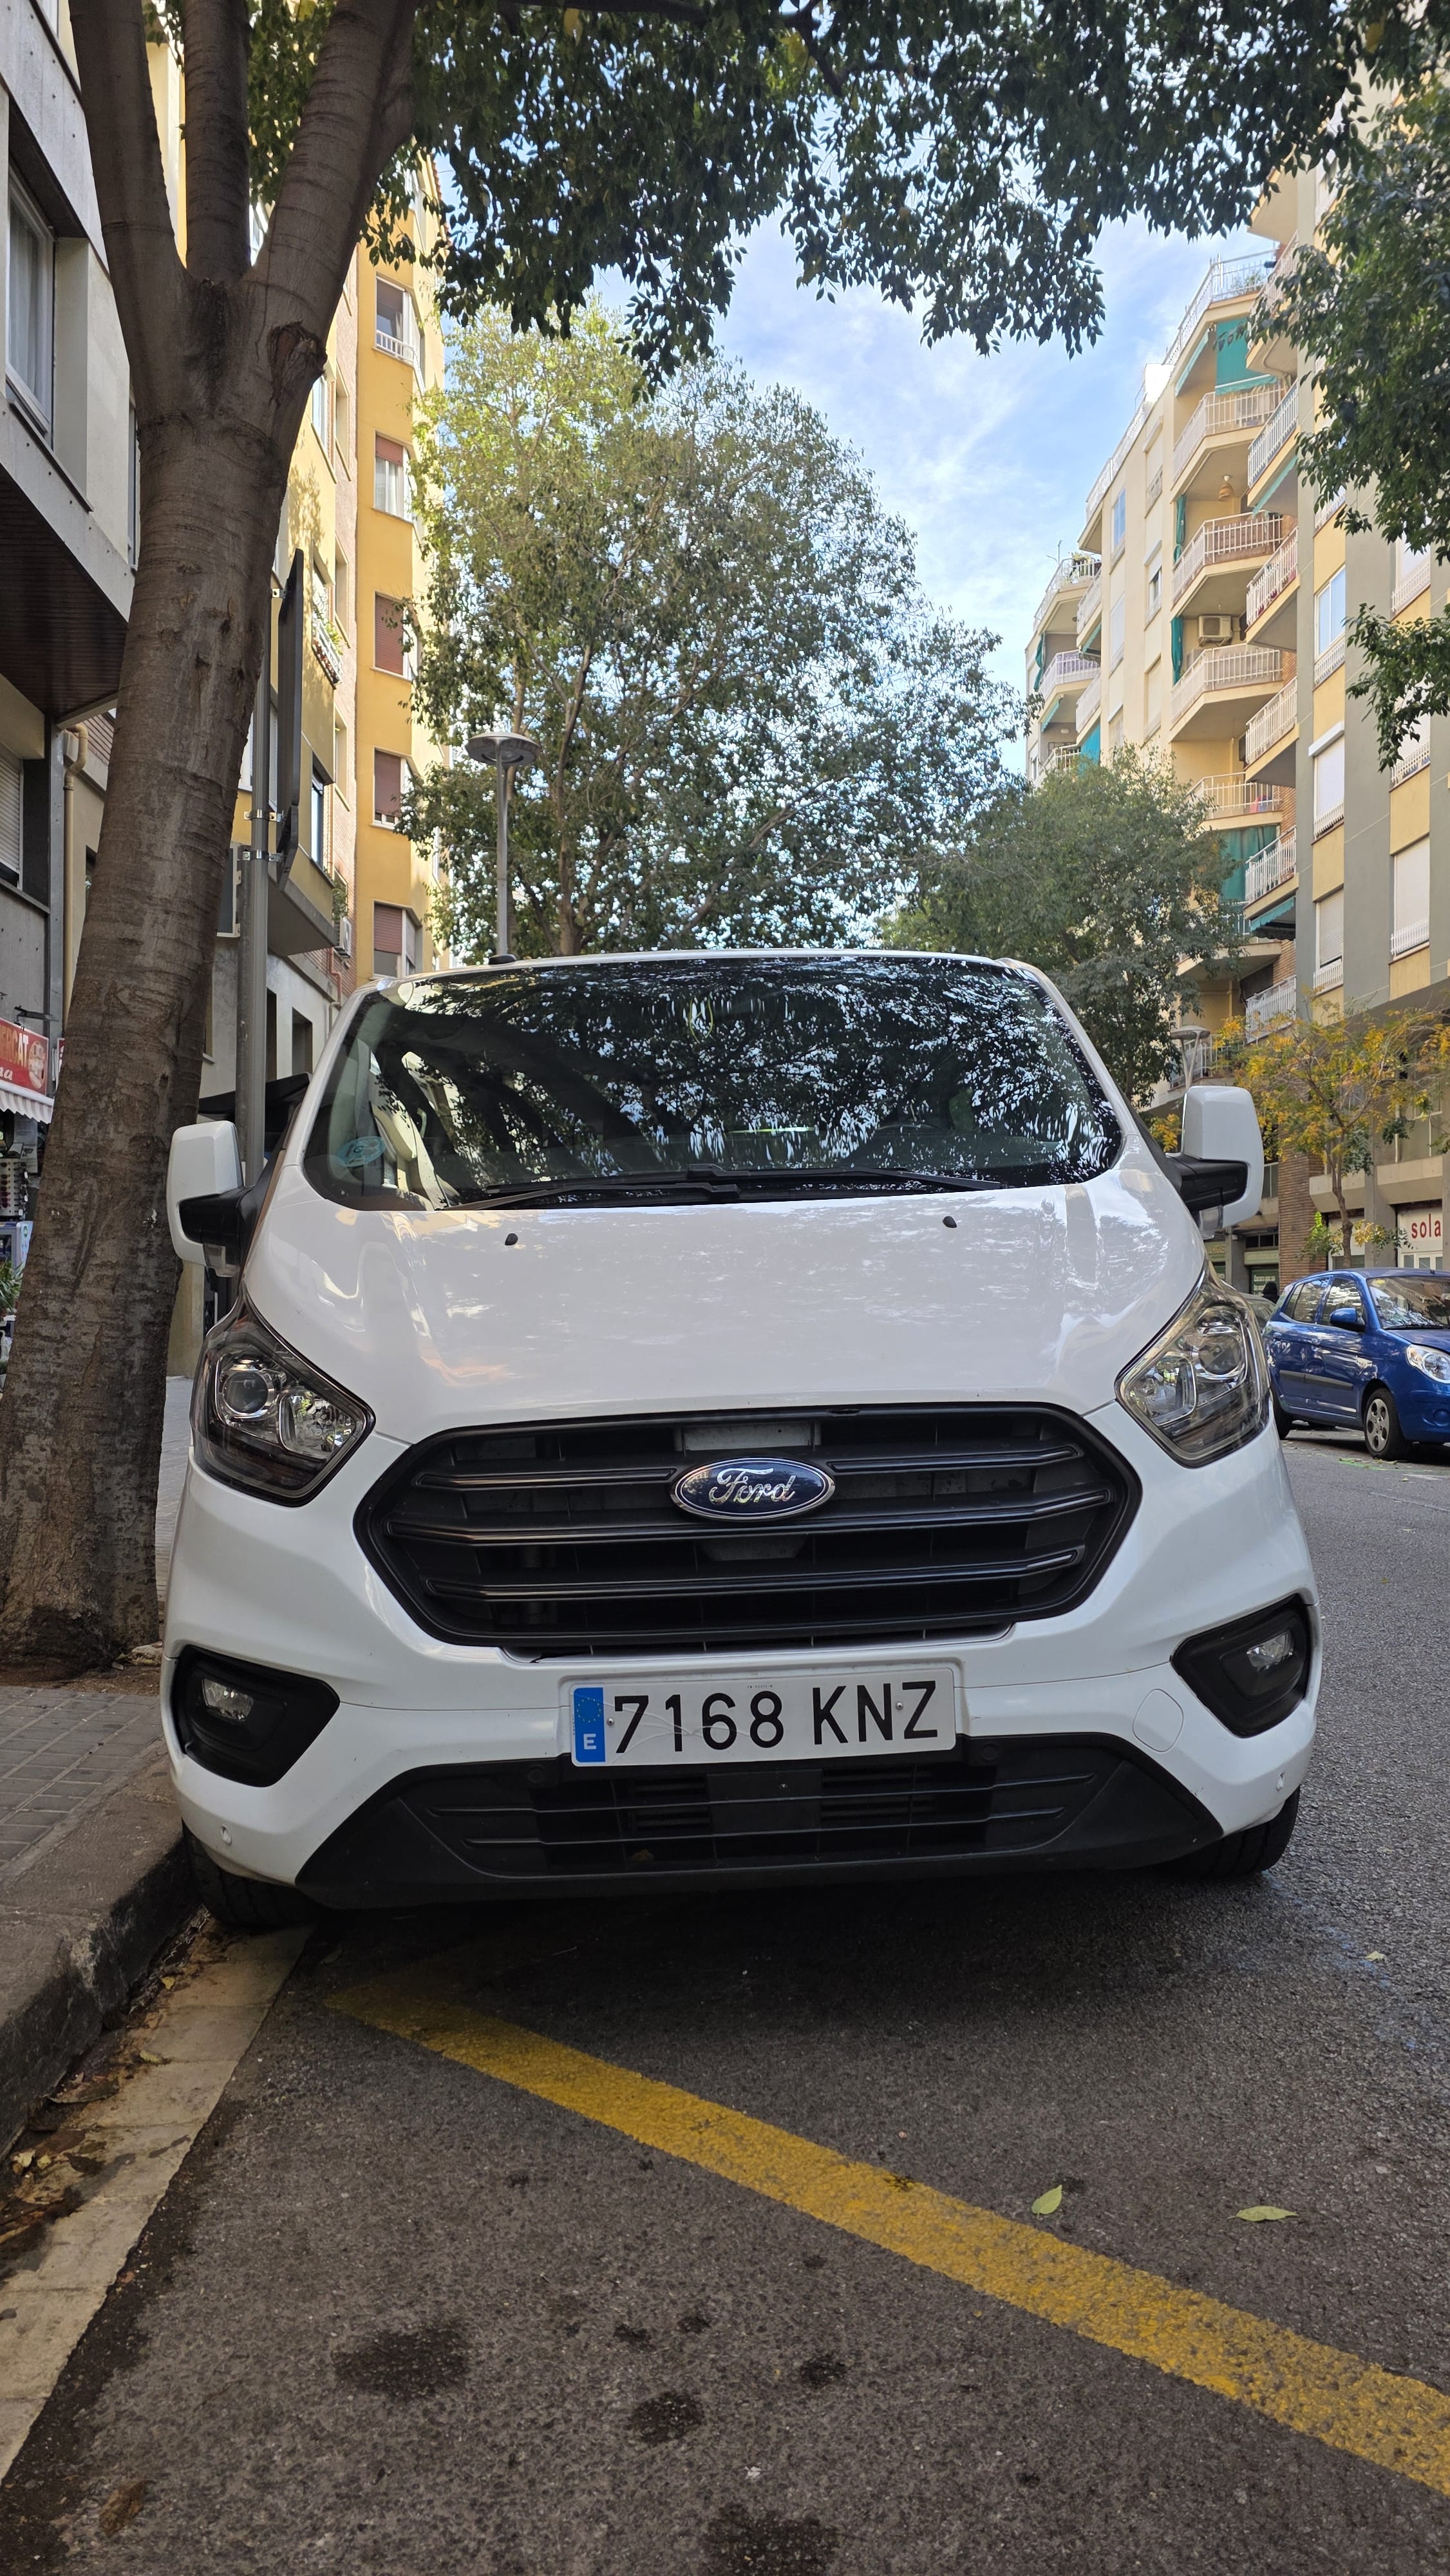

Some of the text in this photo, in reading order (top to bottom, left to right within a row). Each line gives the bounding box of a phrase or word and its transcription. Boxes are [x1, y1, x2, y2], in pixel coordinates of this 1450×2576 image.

[1411, 1213, 1441, 1238] sola
[709, 1468, 796, 1504] Ford
[614, 1680, 938, 1754] 7168 KNZ
[583, 1733, 597, 1750] E
